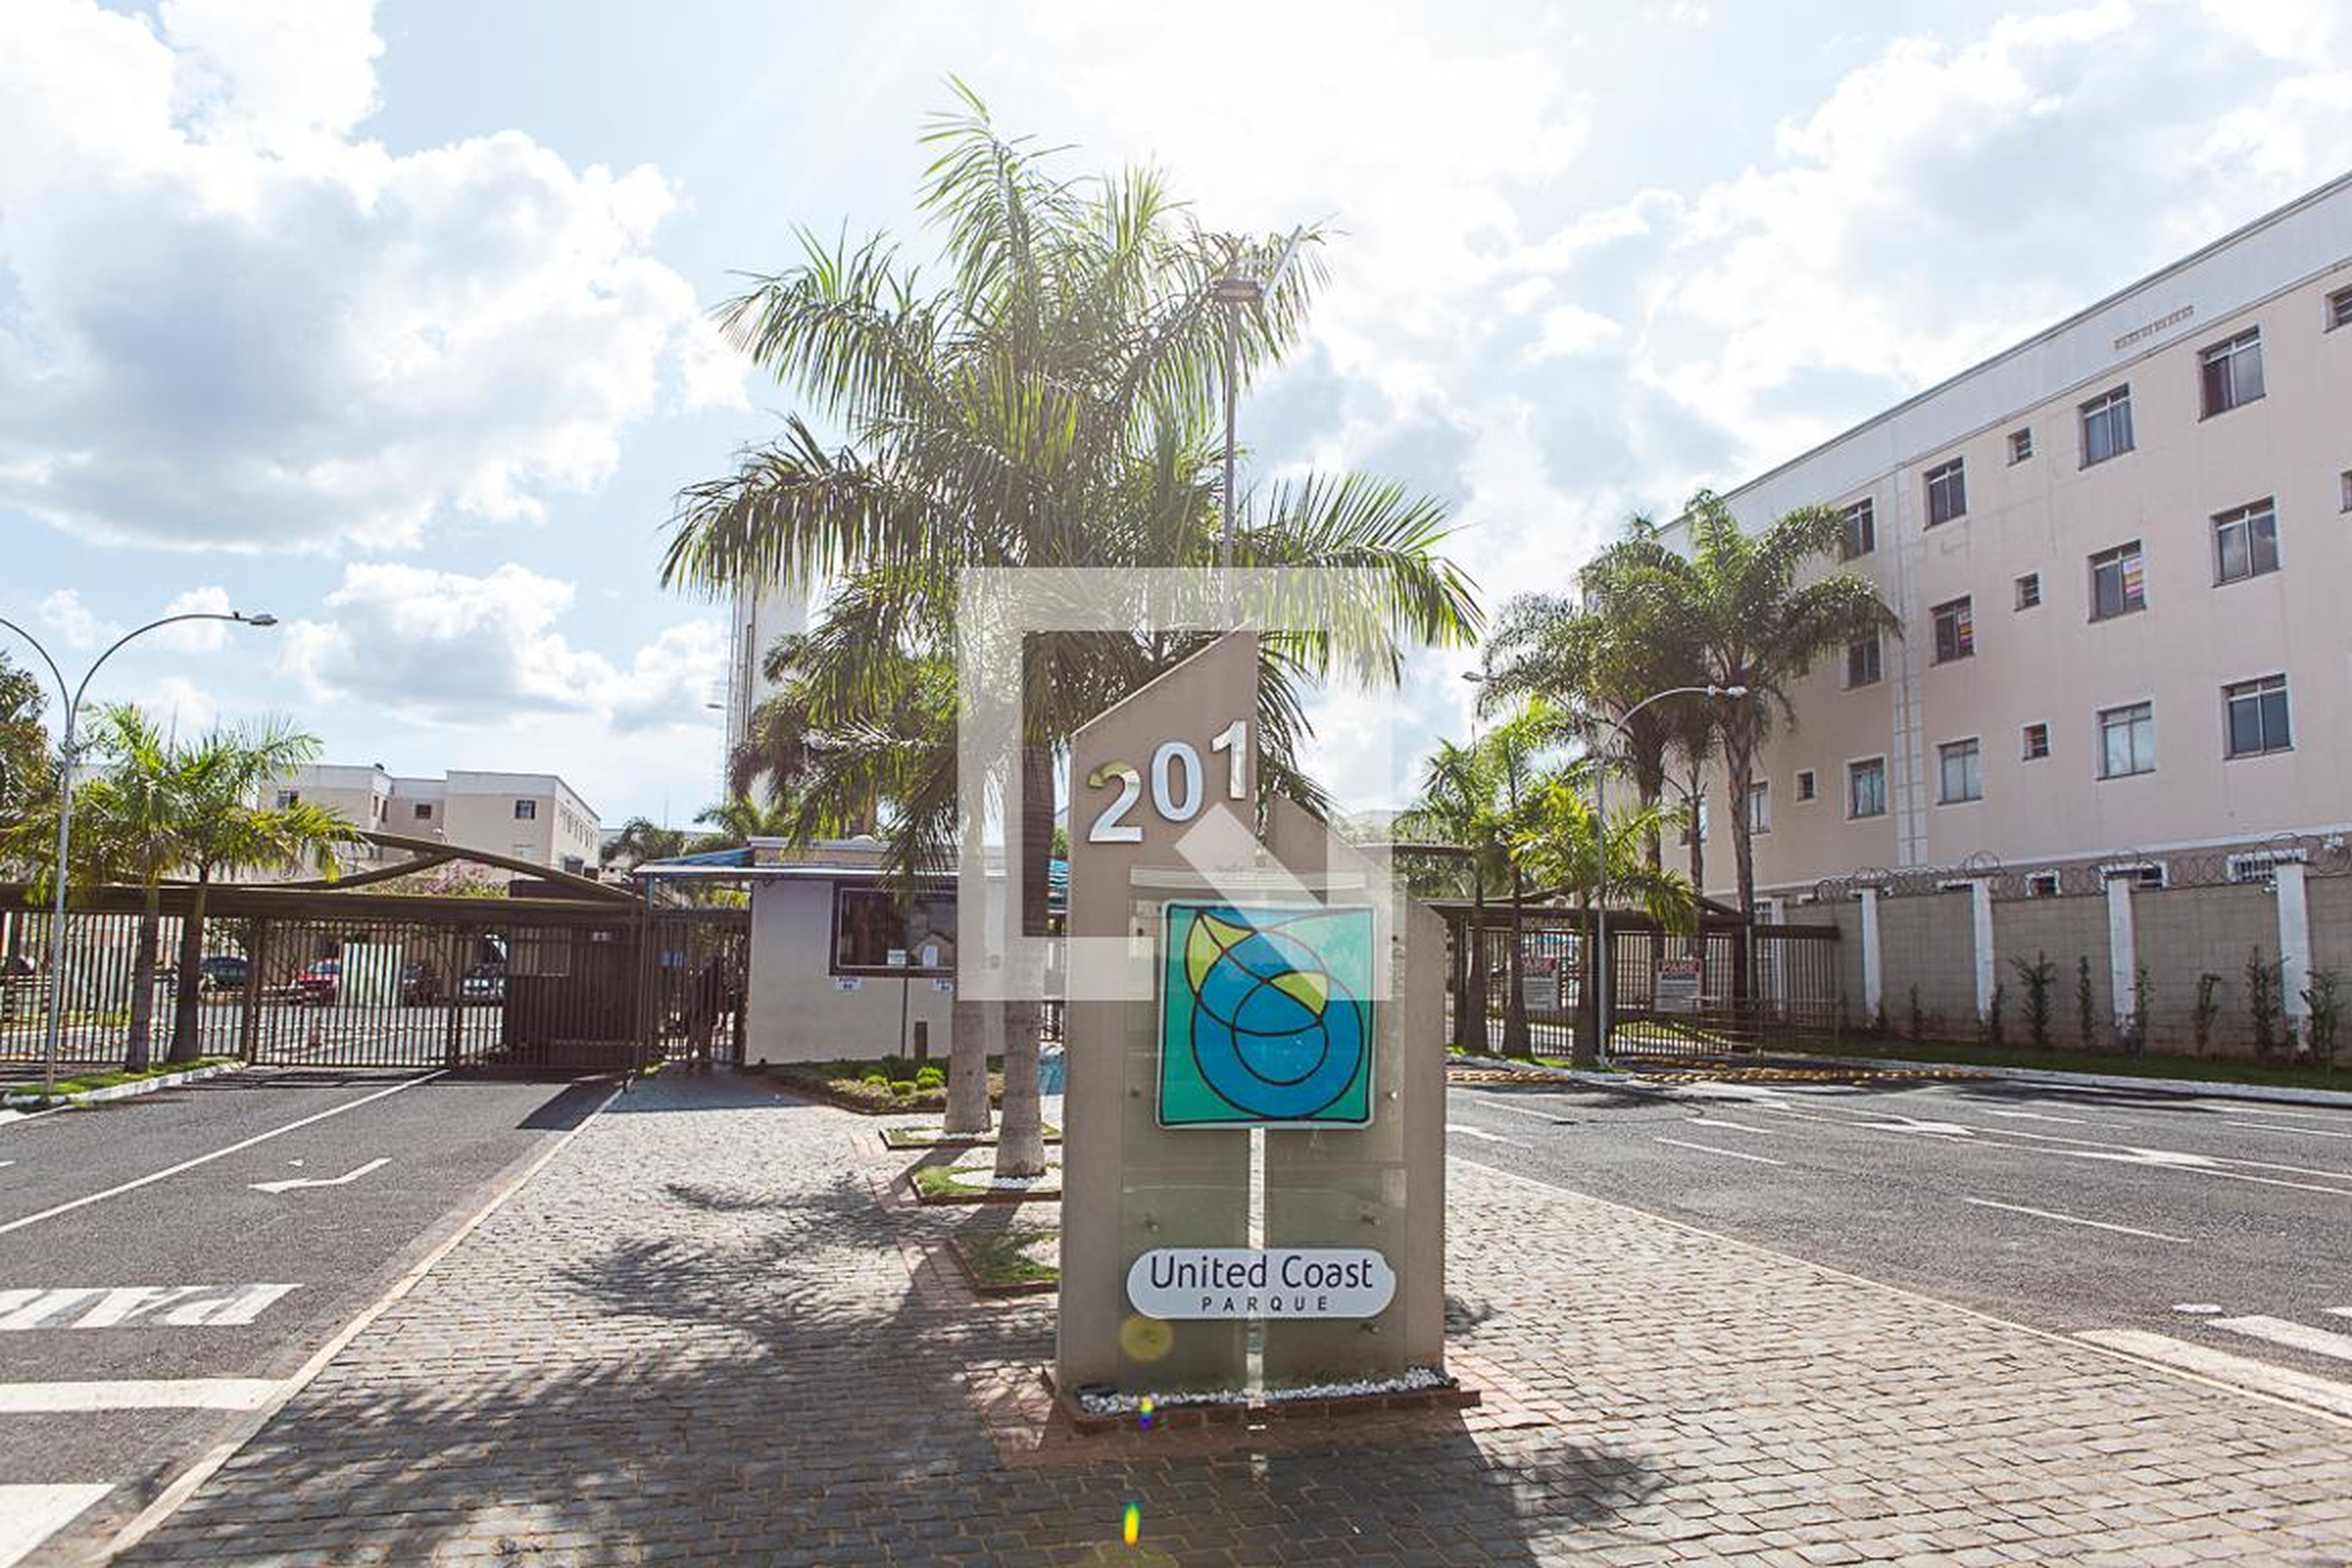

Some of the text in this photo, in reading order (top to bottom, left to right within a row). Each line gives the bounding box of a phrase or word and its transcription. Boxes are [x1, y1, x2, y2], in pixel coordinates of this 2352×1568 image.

[1087, 719, 1246, 842] 201
[1150, 1255, 1373, 1288] United Coast
[1201, 1296, 1329, 1311] PARQUE
